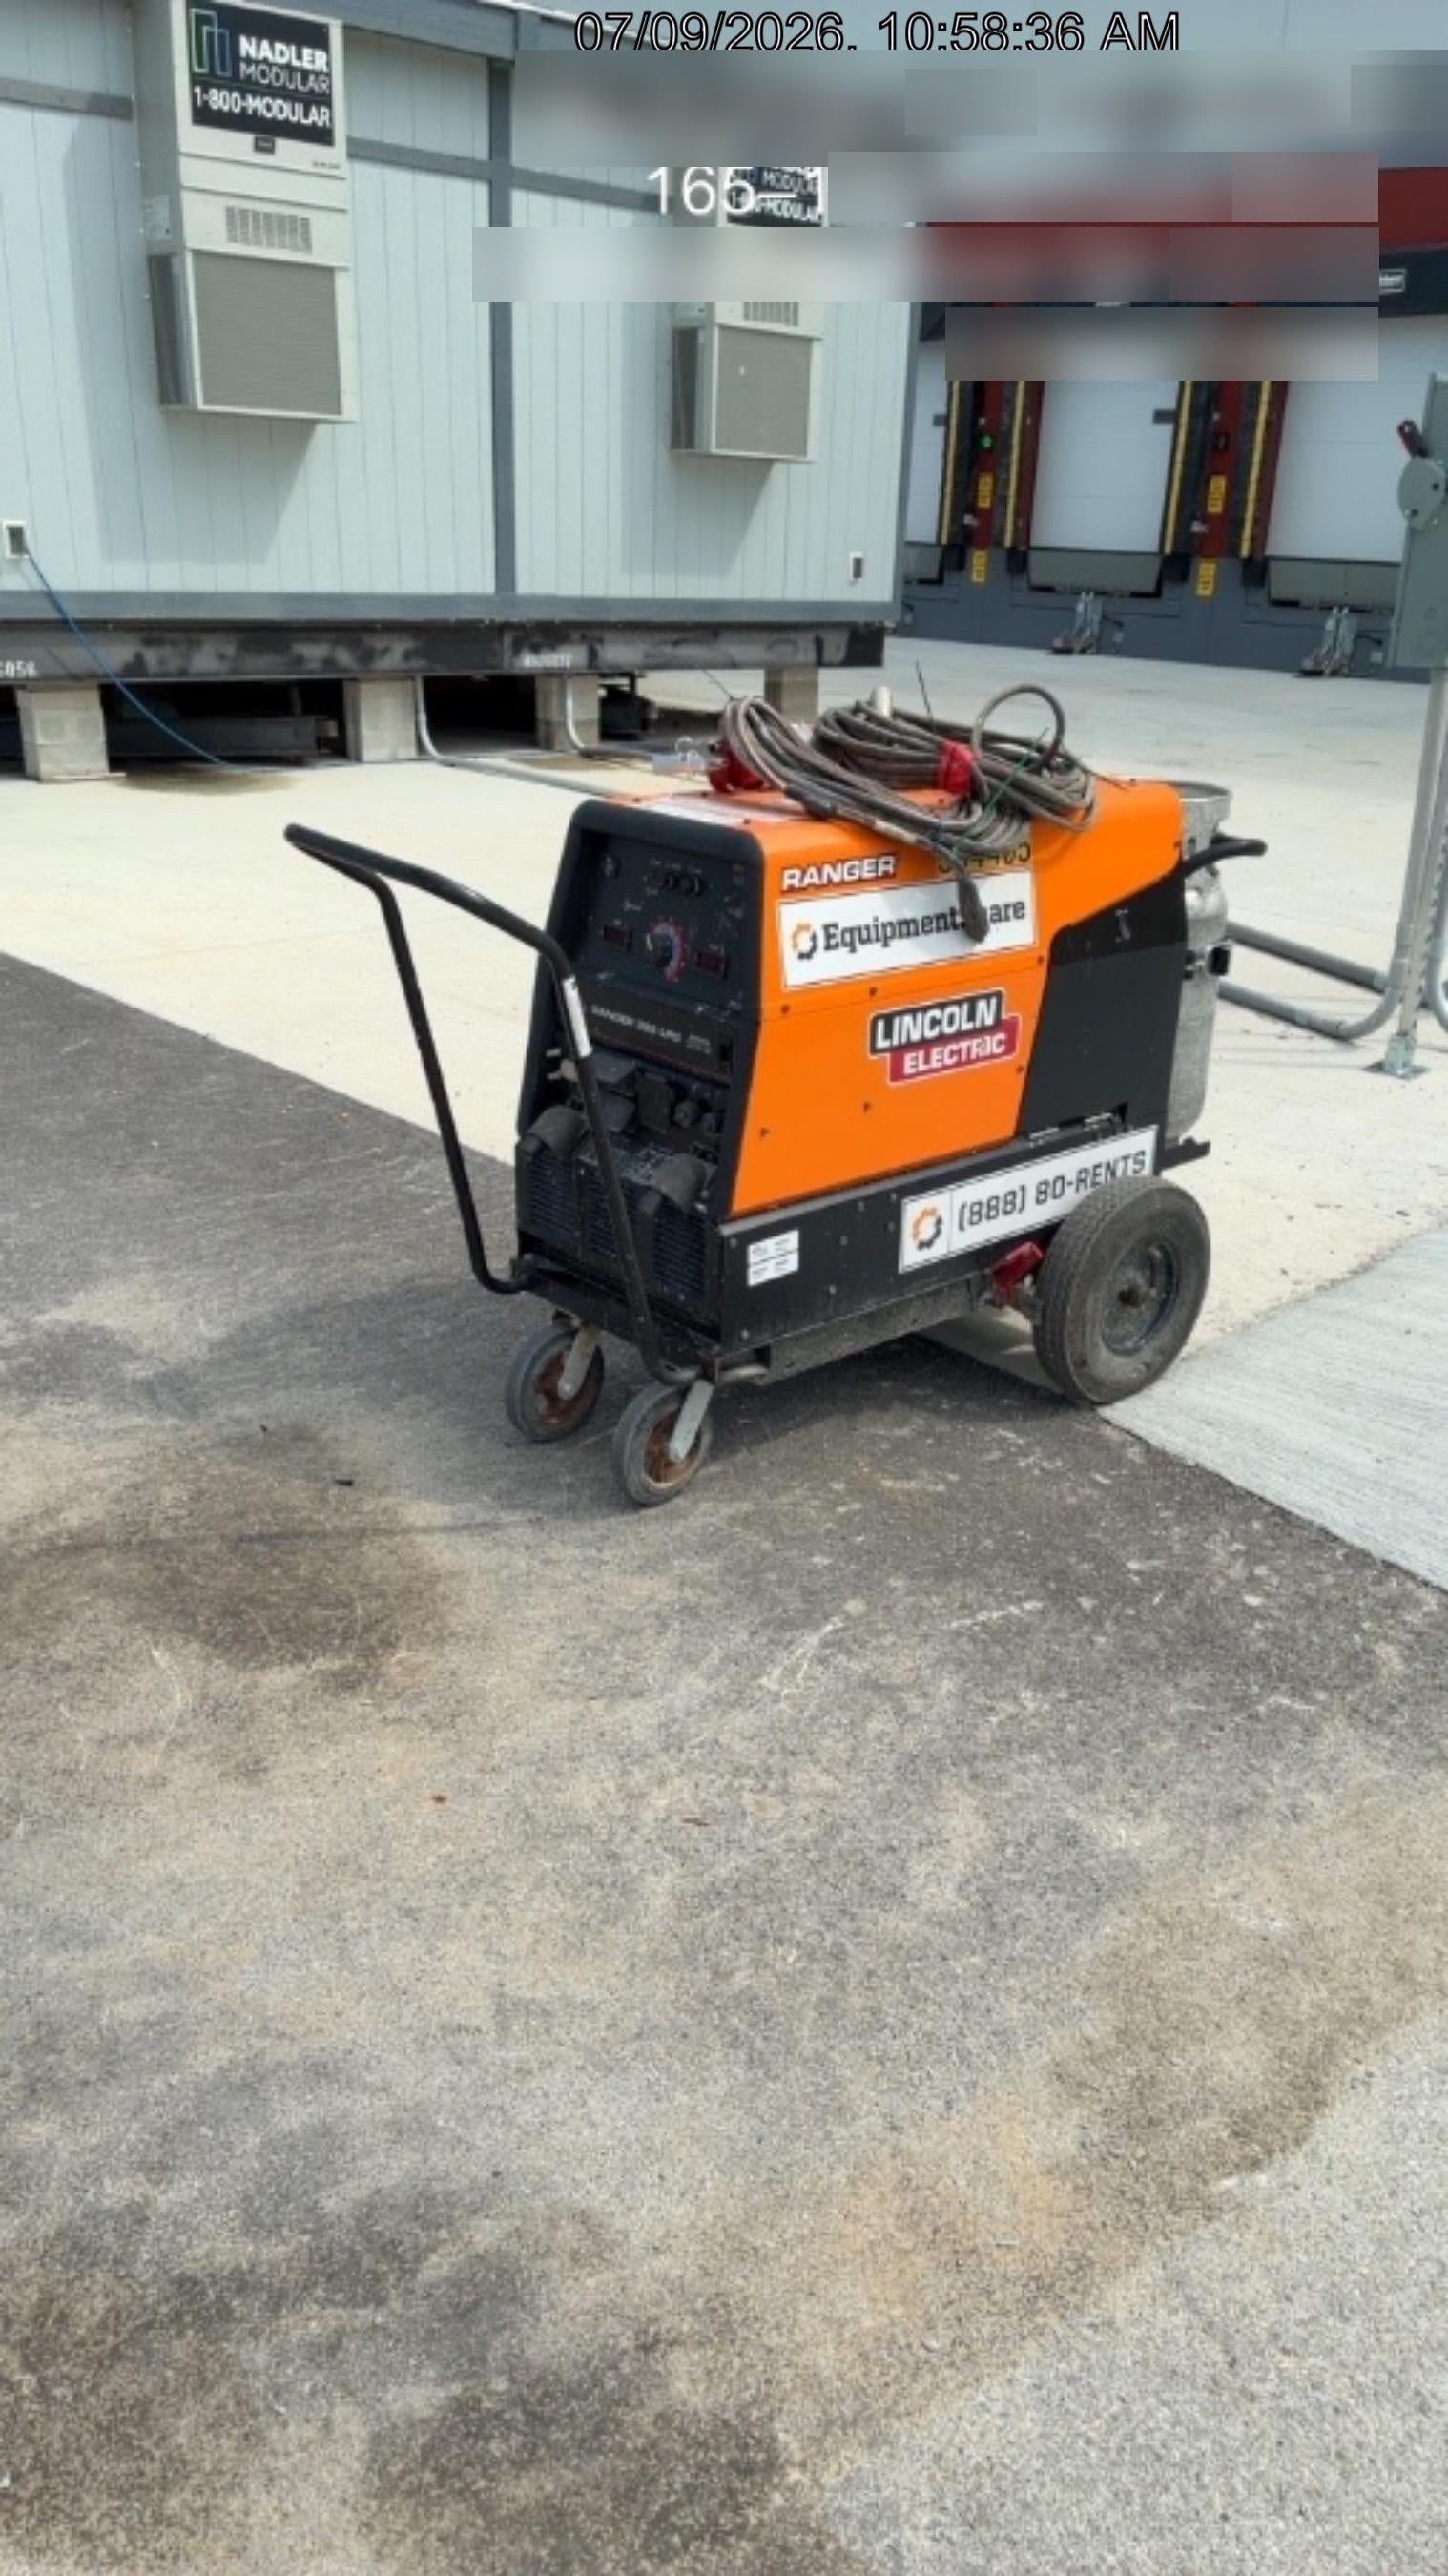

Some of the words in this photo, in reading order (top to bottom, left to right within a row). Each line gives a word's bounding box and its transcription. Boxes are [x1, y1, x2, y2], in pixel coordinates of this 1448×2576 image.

[239, 34, 329, 72] NADLER
[239, 61, 330, 93] MODULAR
[194, 85, 331, 128] 1-800-MODULAR
[781, 855, 897, 891] RANGER
[823, 901, 1025, 953] Equipmentare
[876, 996, 998, 1049] LINCOLN
[903, 1033, 1007, 1075] ELECTRIC
[958, 1184, 1026, 1231] (888)
[1036, 1150, 1146, 1205] 80-RENTS
